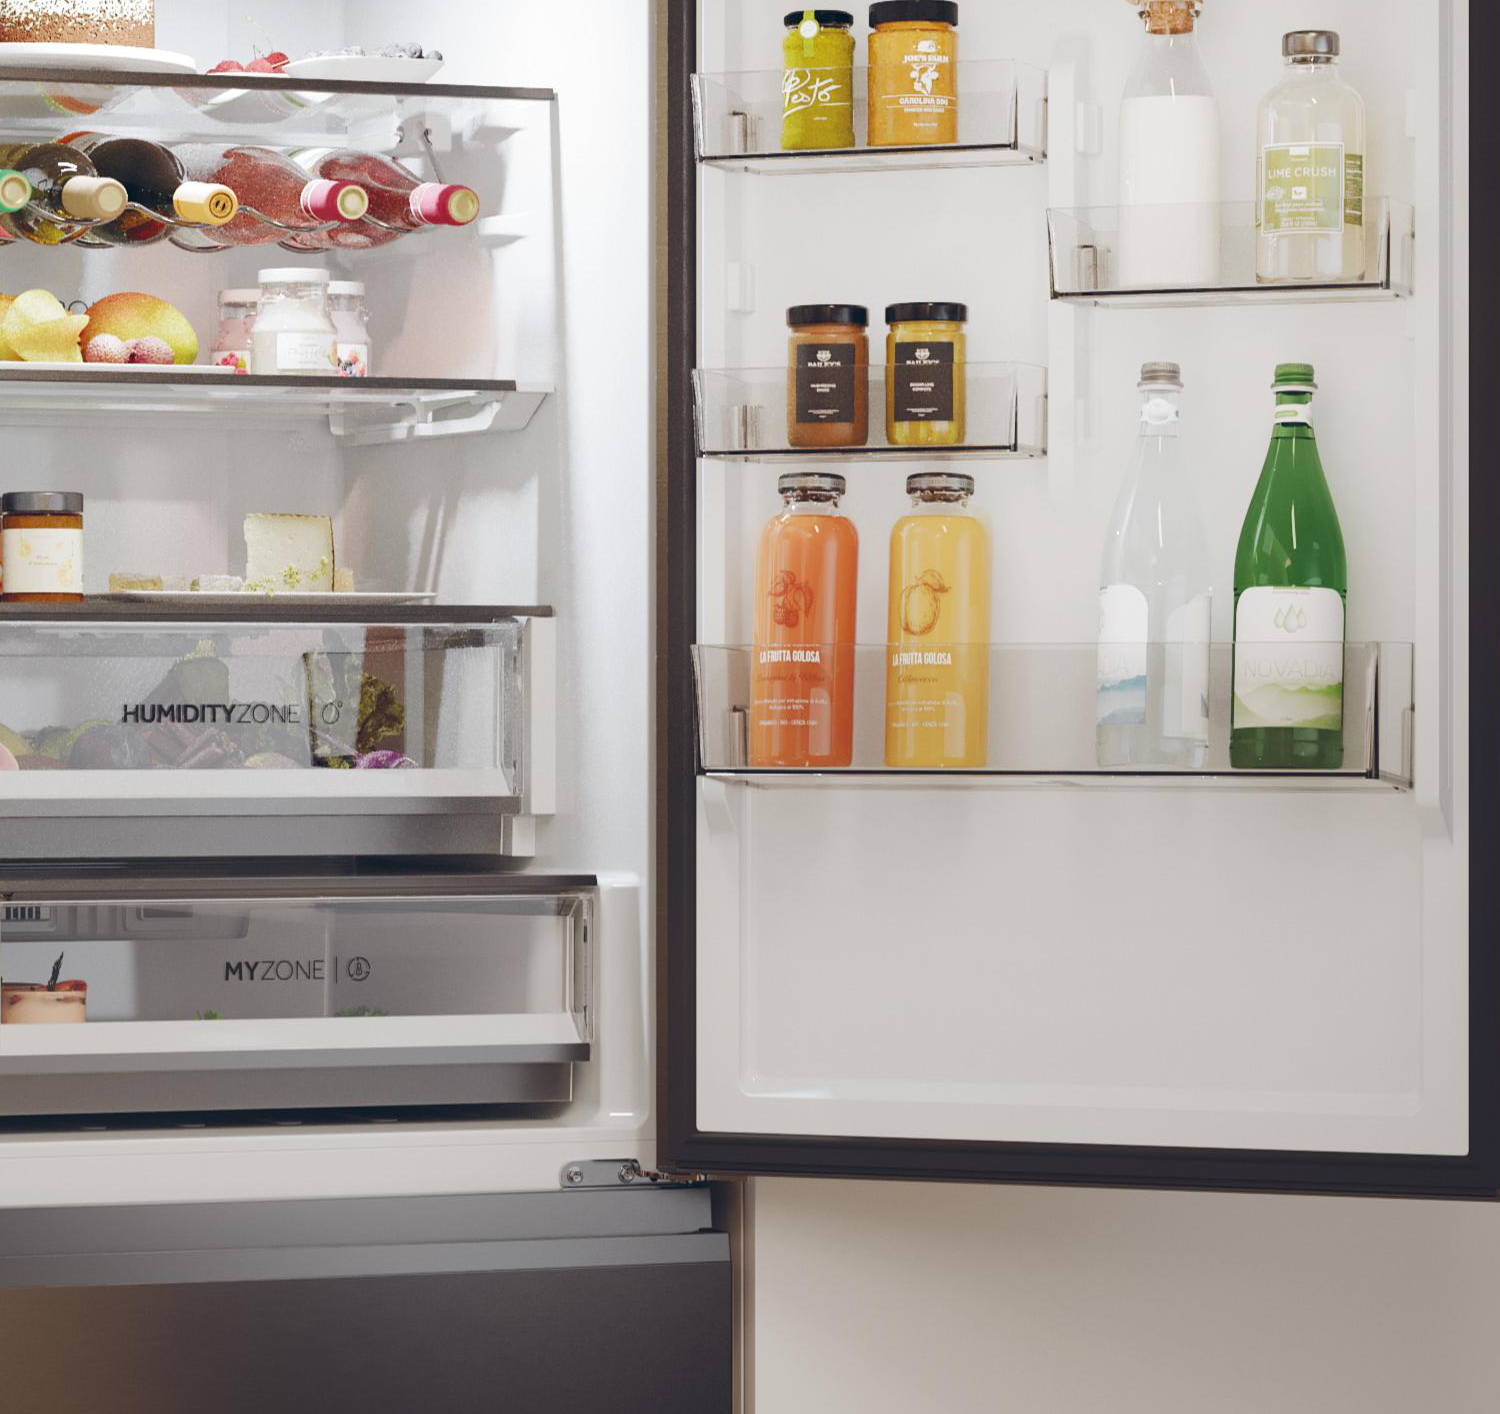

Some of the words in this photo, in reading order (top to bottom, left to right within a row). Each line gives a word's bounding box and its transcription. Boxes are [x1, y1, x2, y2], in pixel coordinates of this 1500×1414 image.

[1268, 169, 1291, 178] LIME
[1294, 166, 1336, 177] CRUSH
[760, 651, 766, 663] LA
[767, 650, 791, 663] FRUTTA
[792, 649, 820, 662] GOLOSA
[892, 653, 899, 666] LA
[900, 652, 923, 665] FRUTTA
[924, 651, 952, 665] GOLOSA
[1244, 657, 1336, 678] NOVADIA
[123, 703, 301, 724] HUMIDITYZONE
[225, 960, 325, 981] MYZONE
